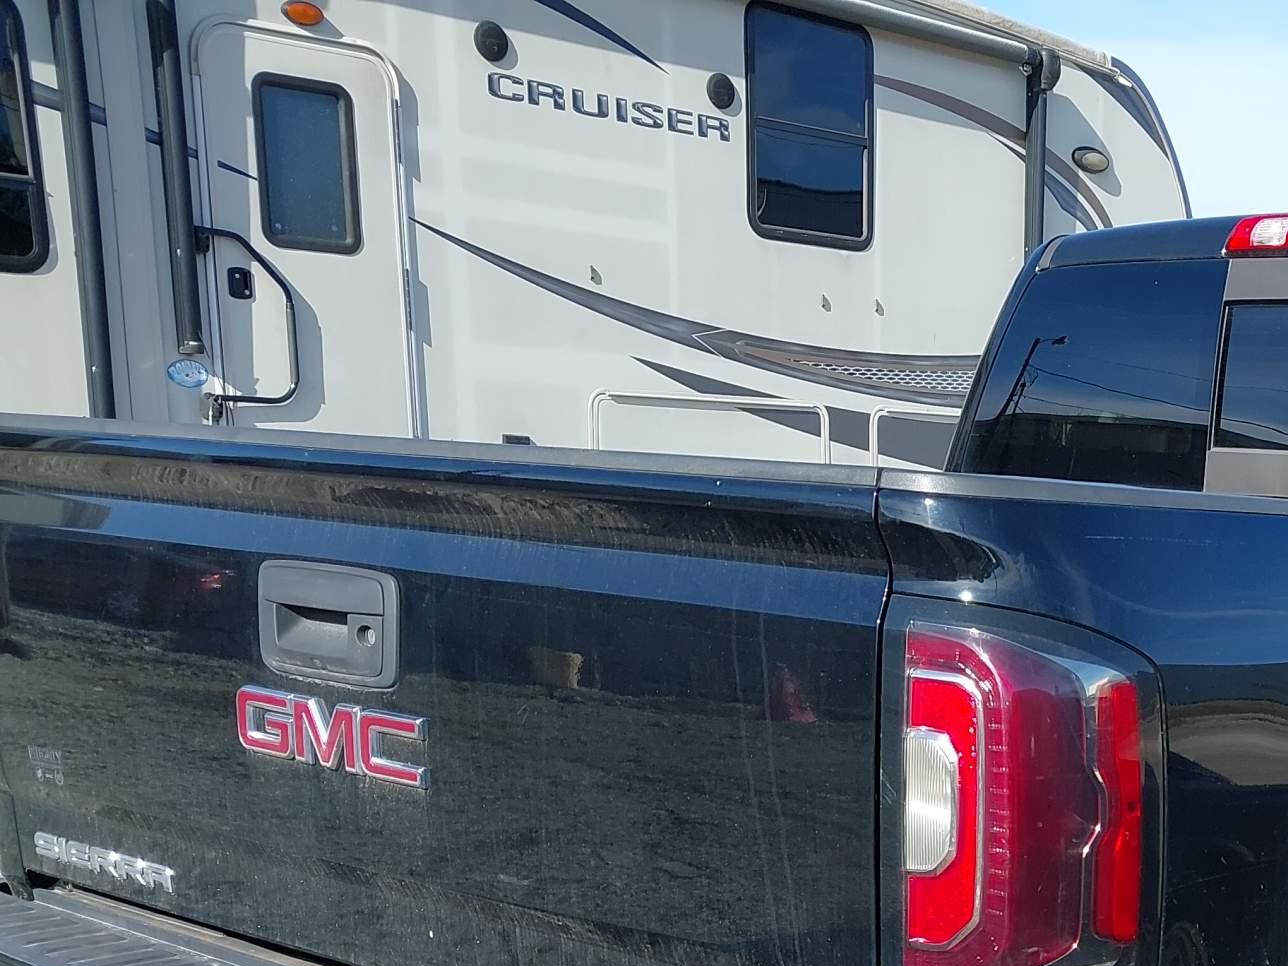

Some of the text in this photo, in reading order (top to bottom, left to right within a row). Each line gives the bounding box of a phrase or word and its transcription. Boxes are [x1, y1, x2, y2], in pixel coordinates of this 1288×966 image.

[487, 71, 731, 143] CRUISER
[235, 684, 431, 790] GMC
[33, 831, 176, 895] SIERRA
